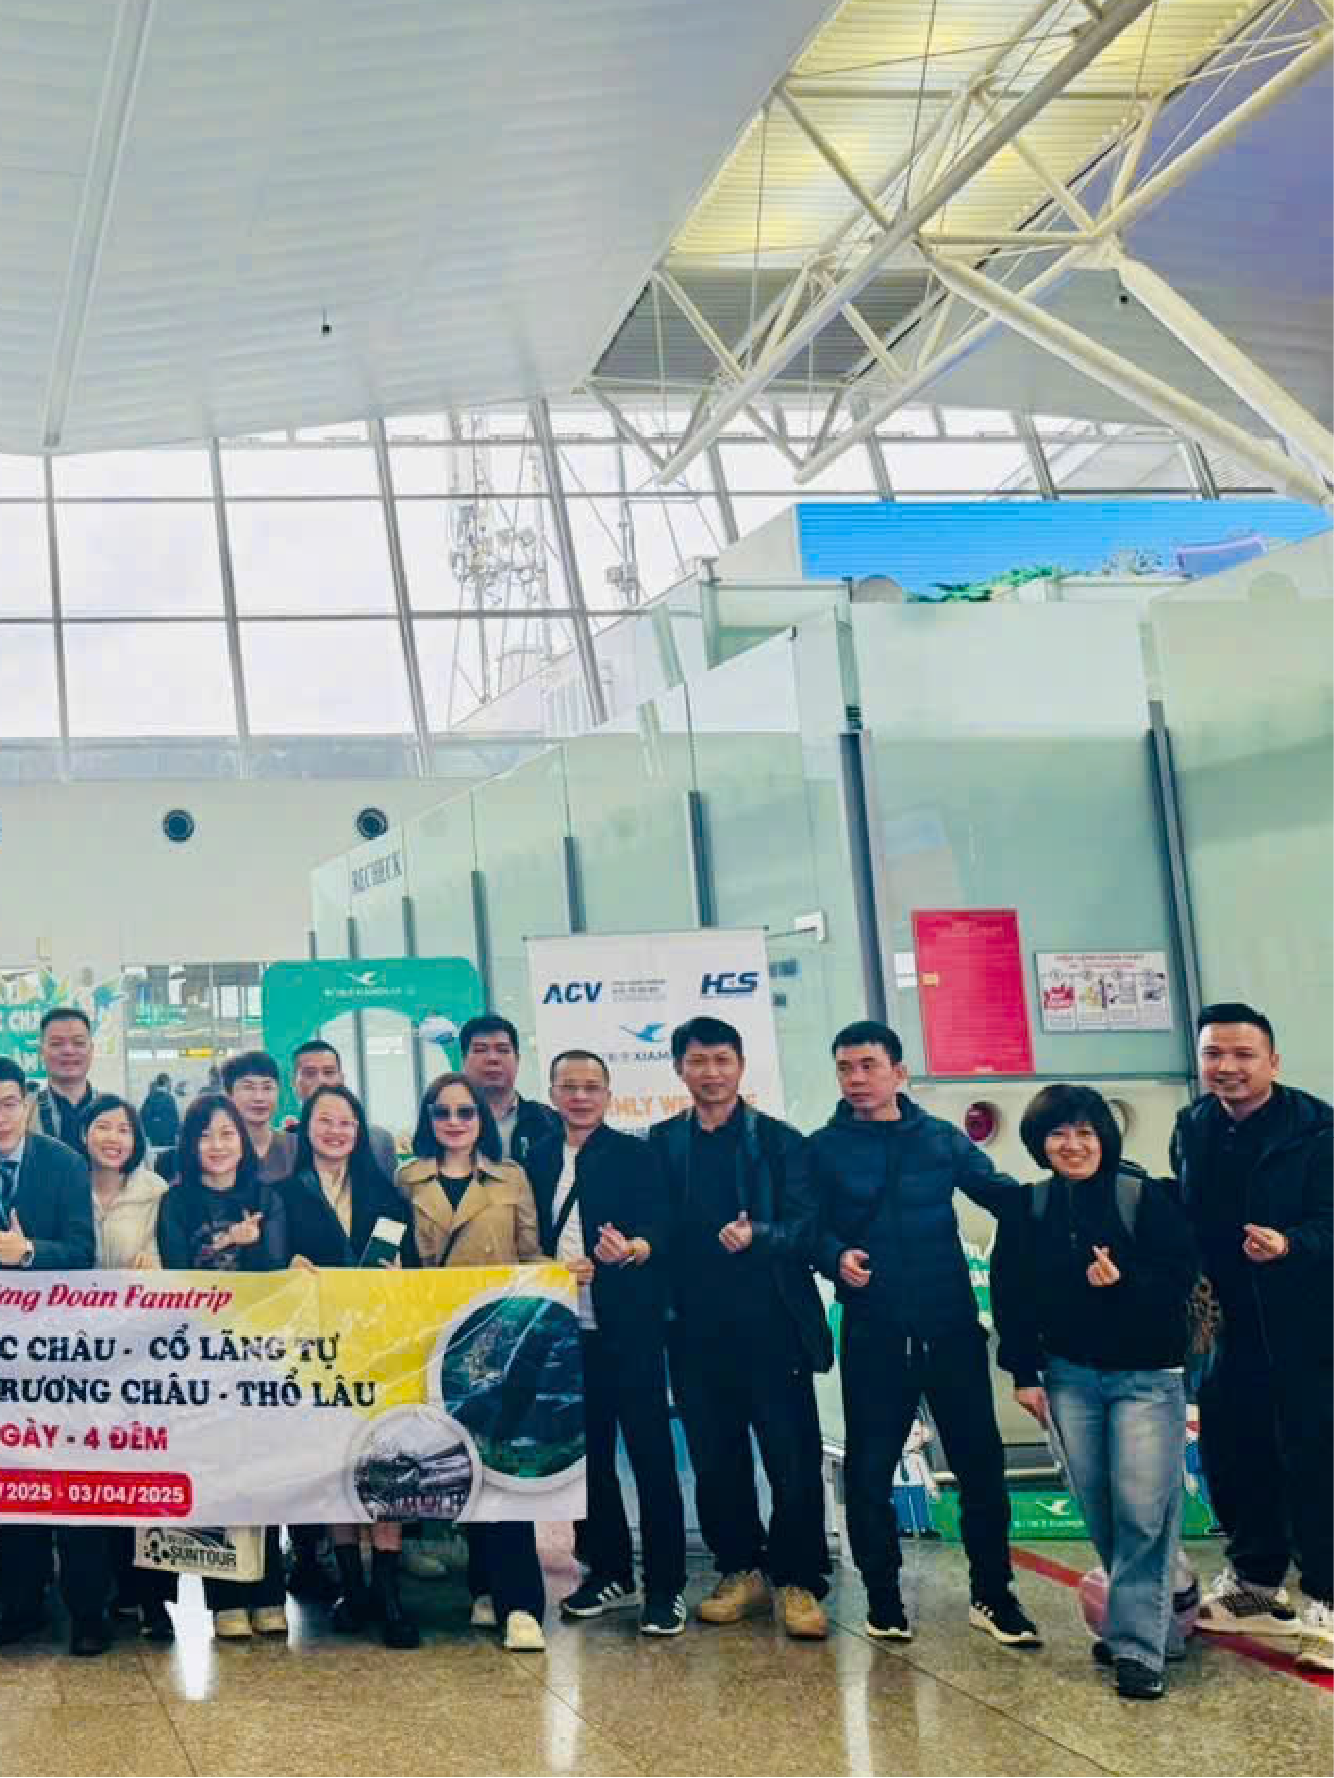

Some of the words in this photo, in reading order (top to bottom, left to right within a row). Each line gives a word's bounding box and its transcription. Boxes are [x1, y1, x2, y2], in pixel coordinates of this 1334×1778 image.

[542, 981, 603, 1004] ACV
[701, 971, 759, 995] HCS
[123, 1283, 233, 1314] Famtrip
[26, 1329, 117, 1362] CHÂU
[148, 1322, 191, 1362] CỔ
[294, 1331, 341, 1370] TỰ
[120, 1371, 210, 1405] CHÂU
[235, 1366, 303, 1407] THỔ
[311, 1373, 377, 1407] LÂU
[83, 1426, 100, 1450] 4
[108, 1421, 168, 1451] ĐÊM
[68, 1484, 185, 1505] 03/04/2025
[168, 1545, 237, 1567] SUNTOUR
